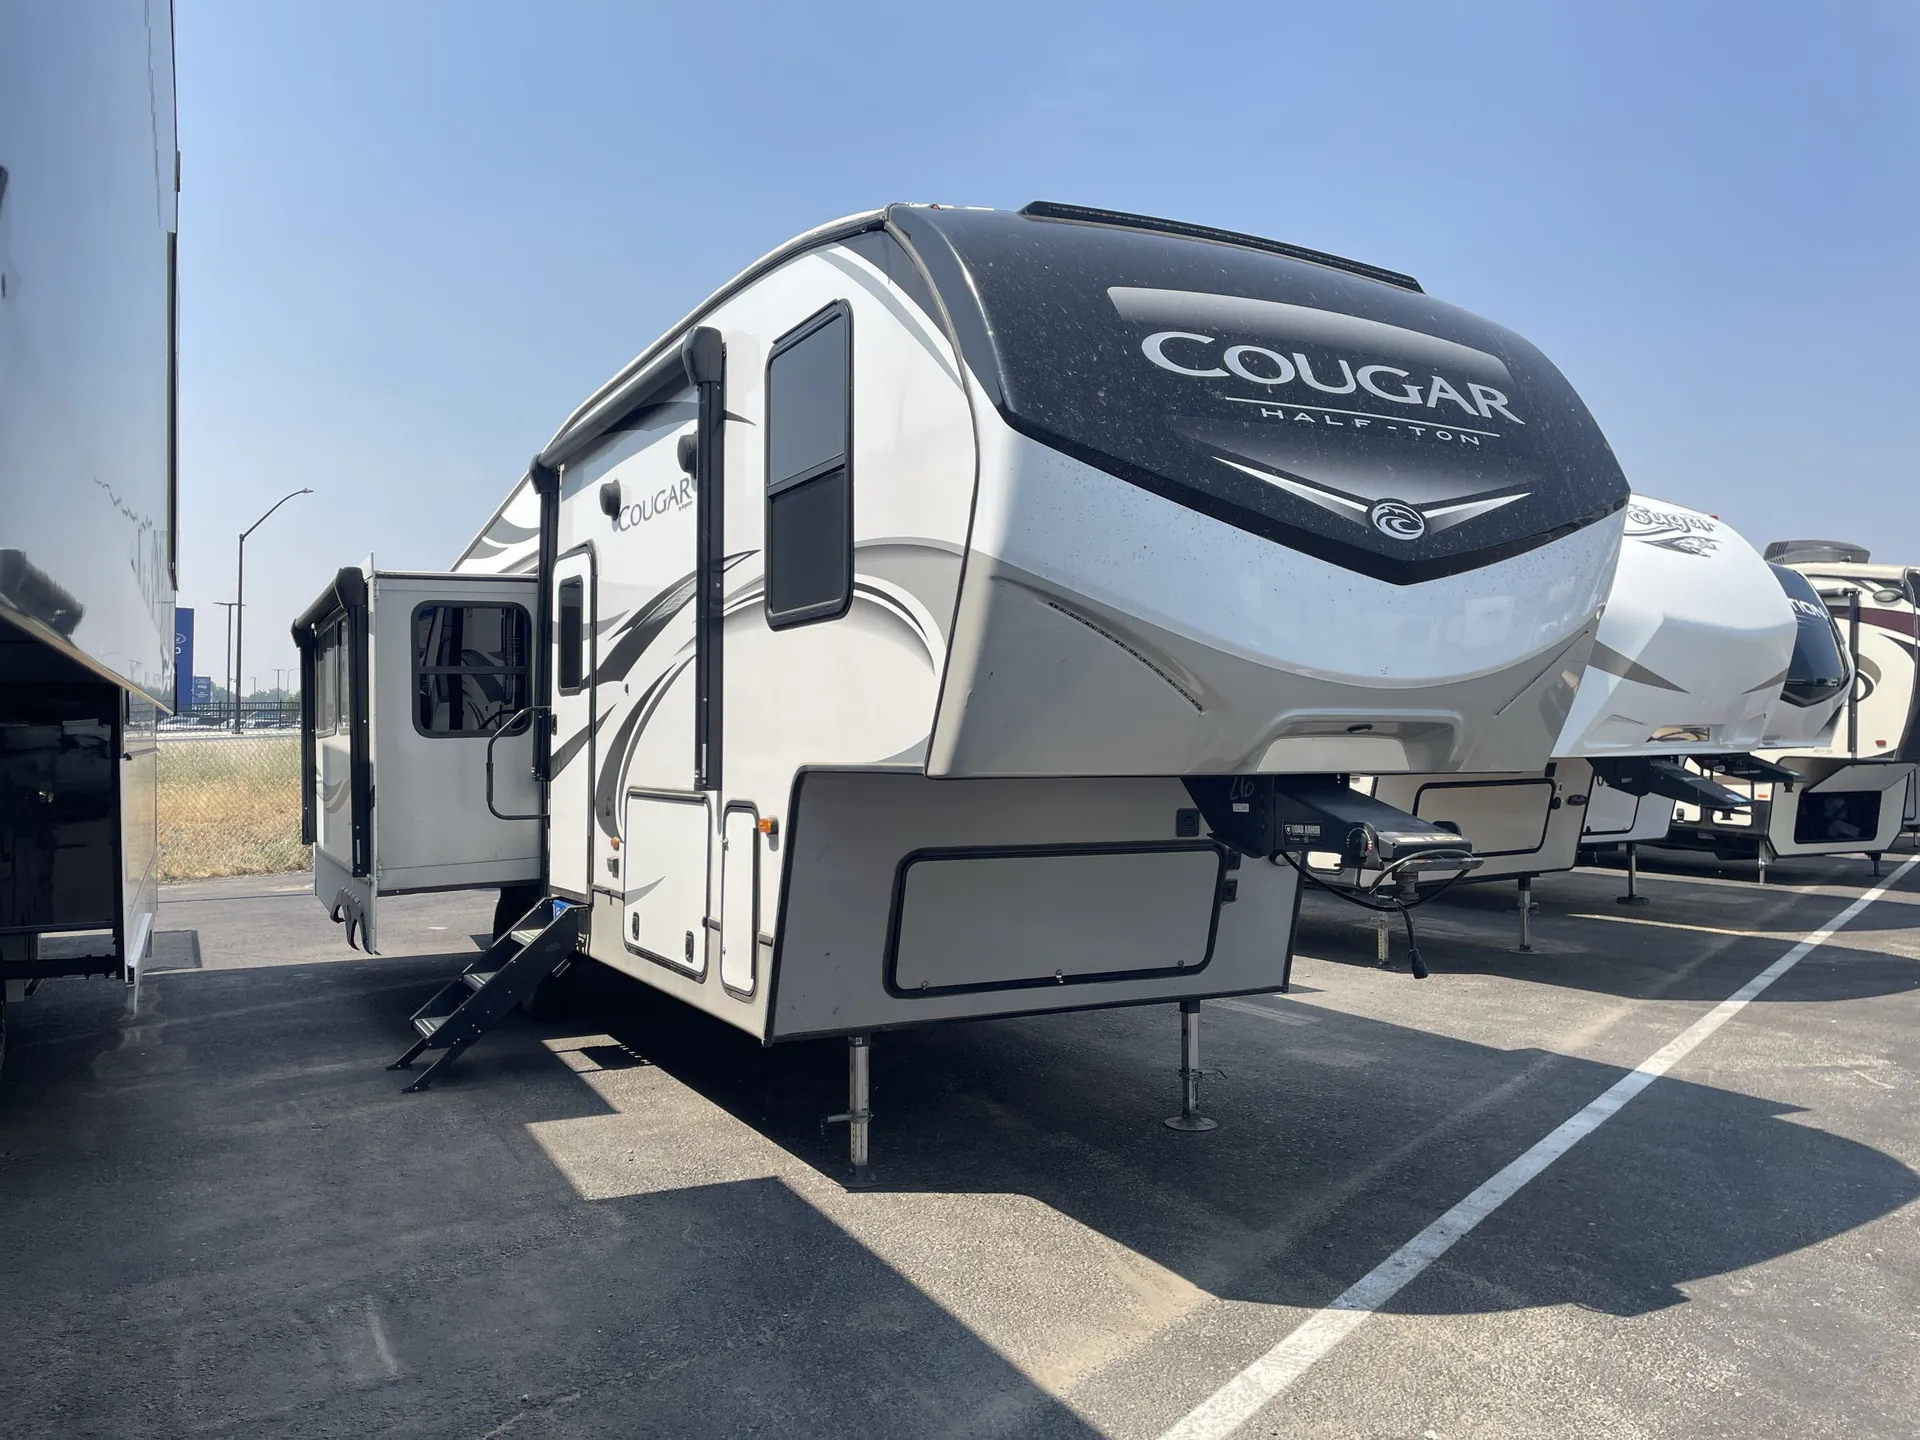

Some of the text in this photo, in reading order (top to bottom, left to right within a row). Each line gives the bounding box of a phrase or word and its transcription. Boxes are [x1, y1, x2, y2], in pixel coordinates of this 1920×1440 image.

[1141, 331, 1526, 425] COUGAR
[1260, 407, 1480, 446] HALF-TON
[618, 477, 692, 533] COUGAR
[1628, 504, 1716, 534] ougar
